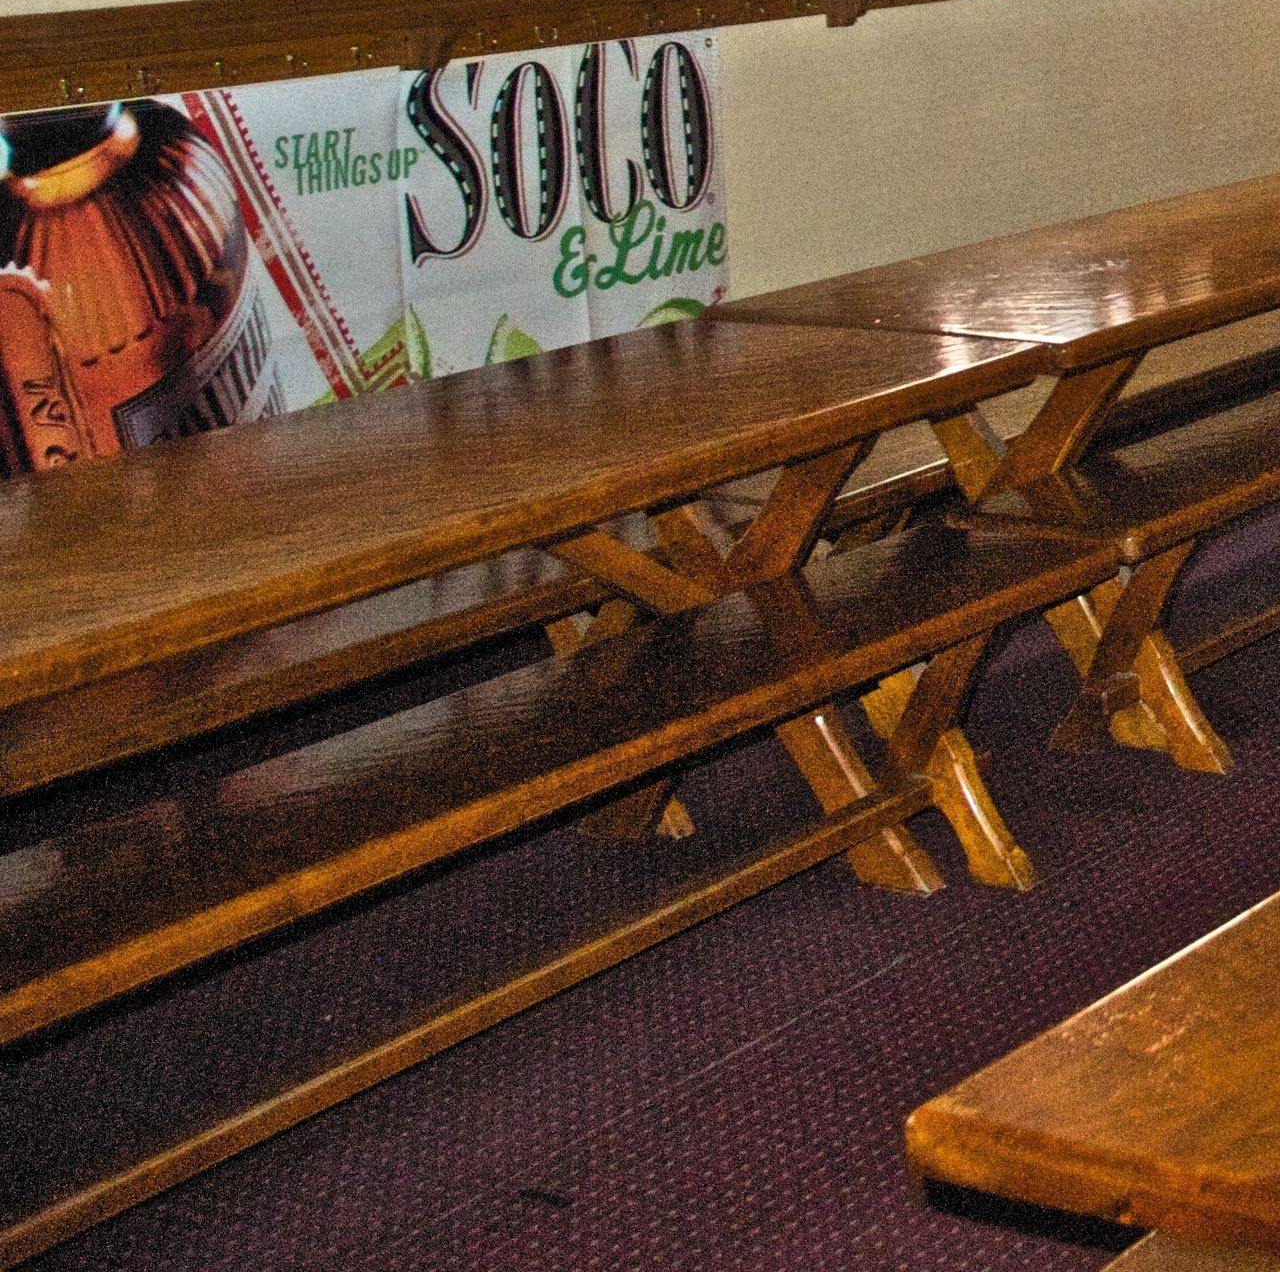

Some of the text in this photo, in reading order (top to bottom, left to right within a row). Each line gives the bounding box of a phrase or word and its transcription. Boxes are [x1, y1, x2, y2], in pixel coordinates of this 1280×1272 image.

[274, 127, 356, 169] START
[294, 147, 418, 196] THINGS UP
[595, 199, 726, 290] Lime
